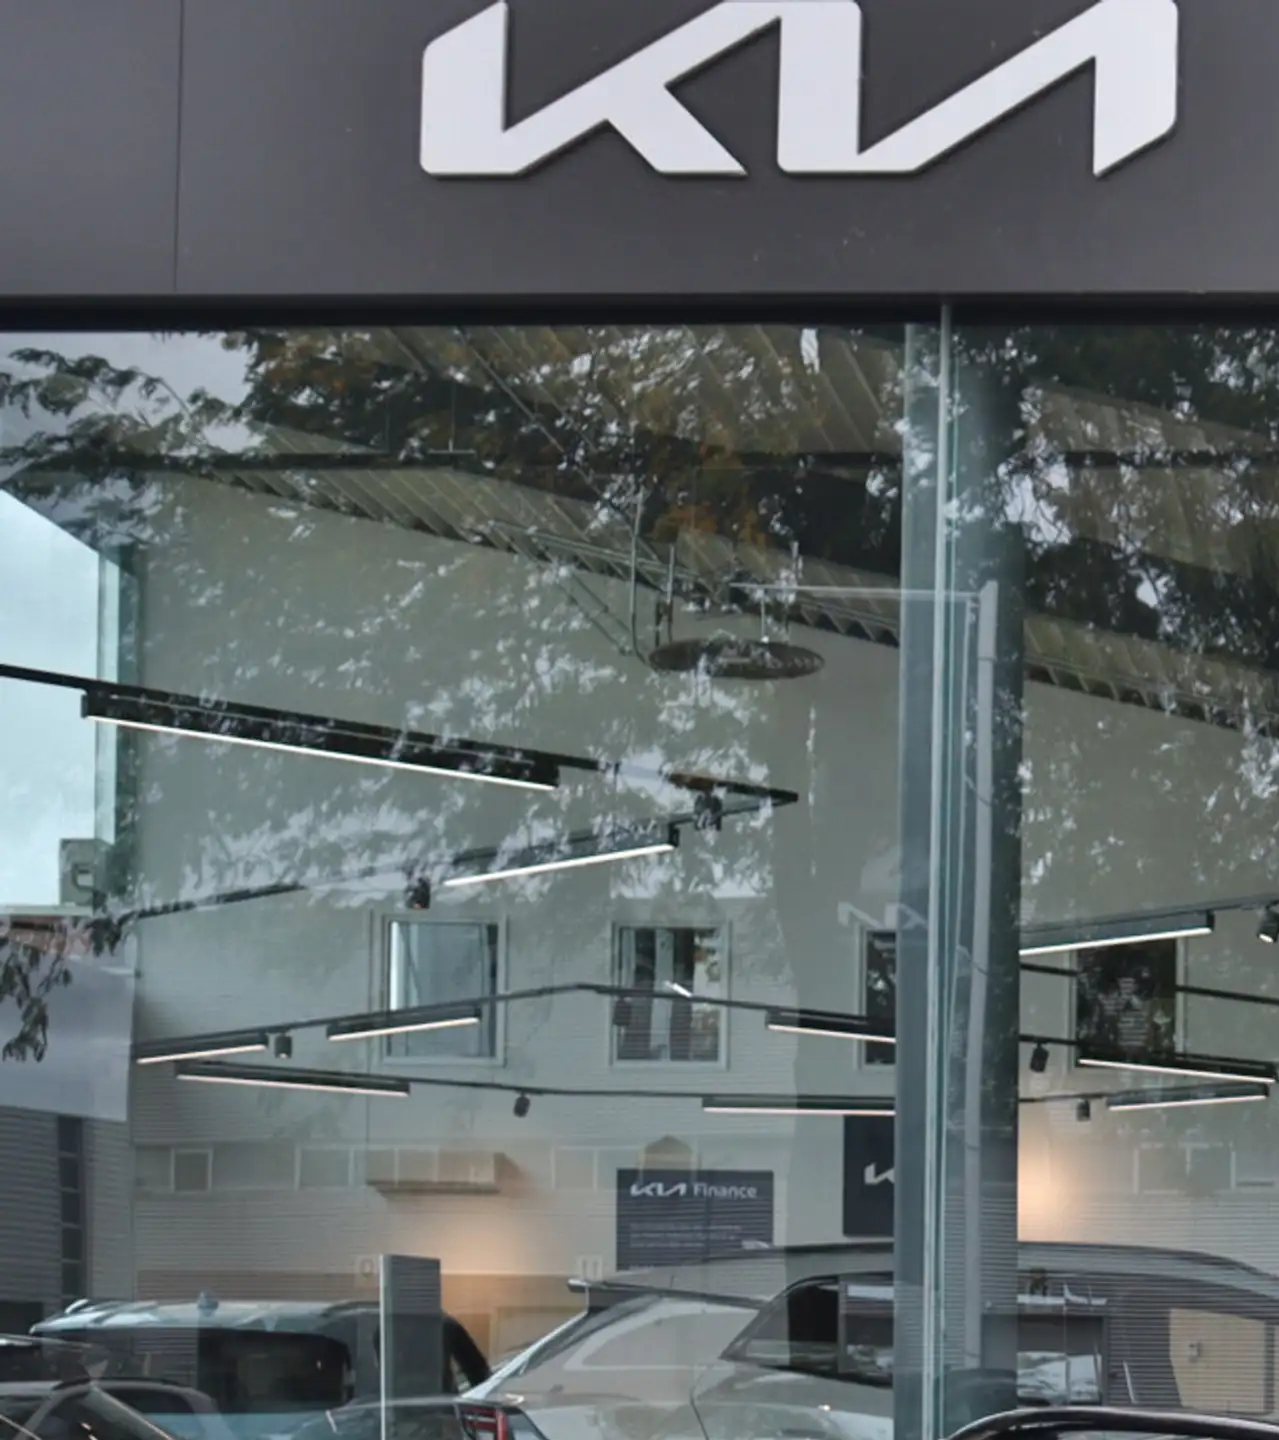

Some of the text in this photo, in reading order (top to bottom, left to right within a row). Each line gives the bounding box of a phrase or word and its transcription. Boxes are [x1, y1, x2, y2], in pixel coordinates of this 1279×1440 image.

[420, 0, 1180, 178] KIA
[630, 1182, 758, 1198] KIA Finance
